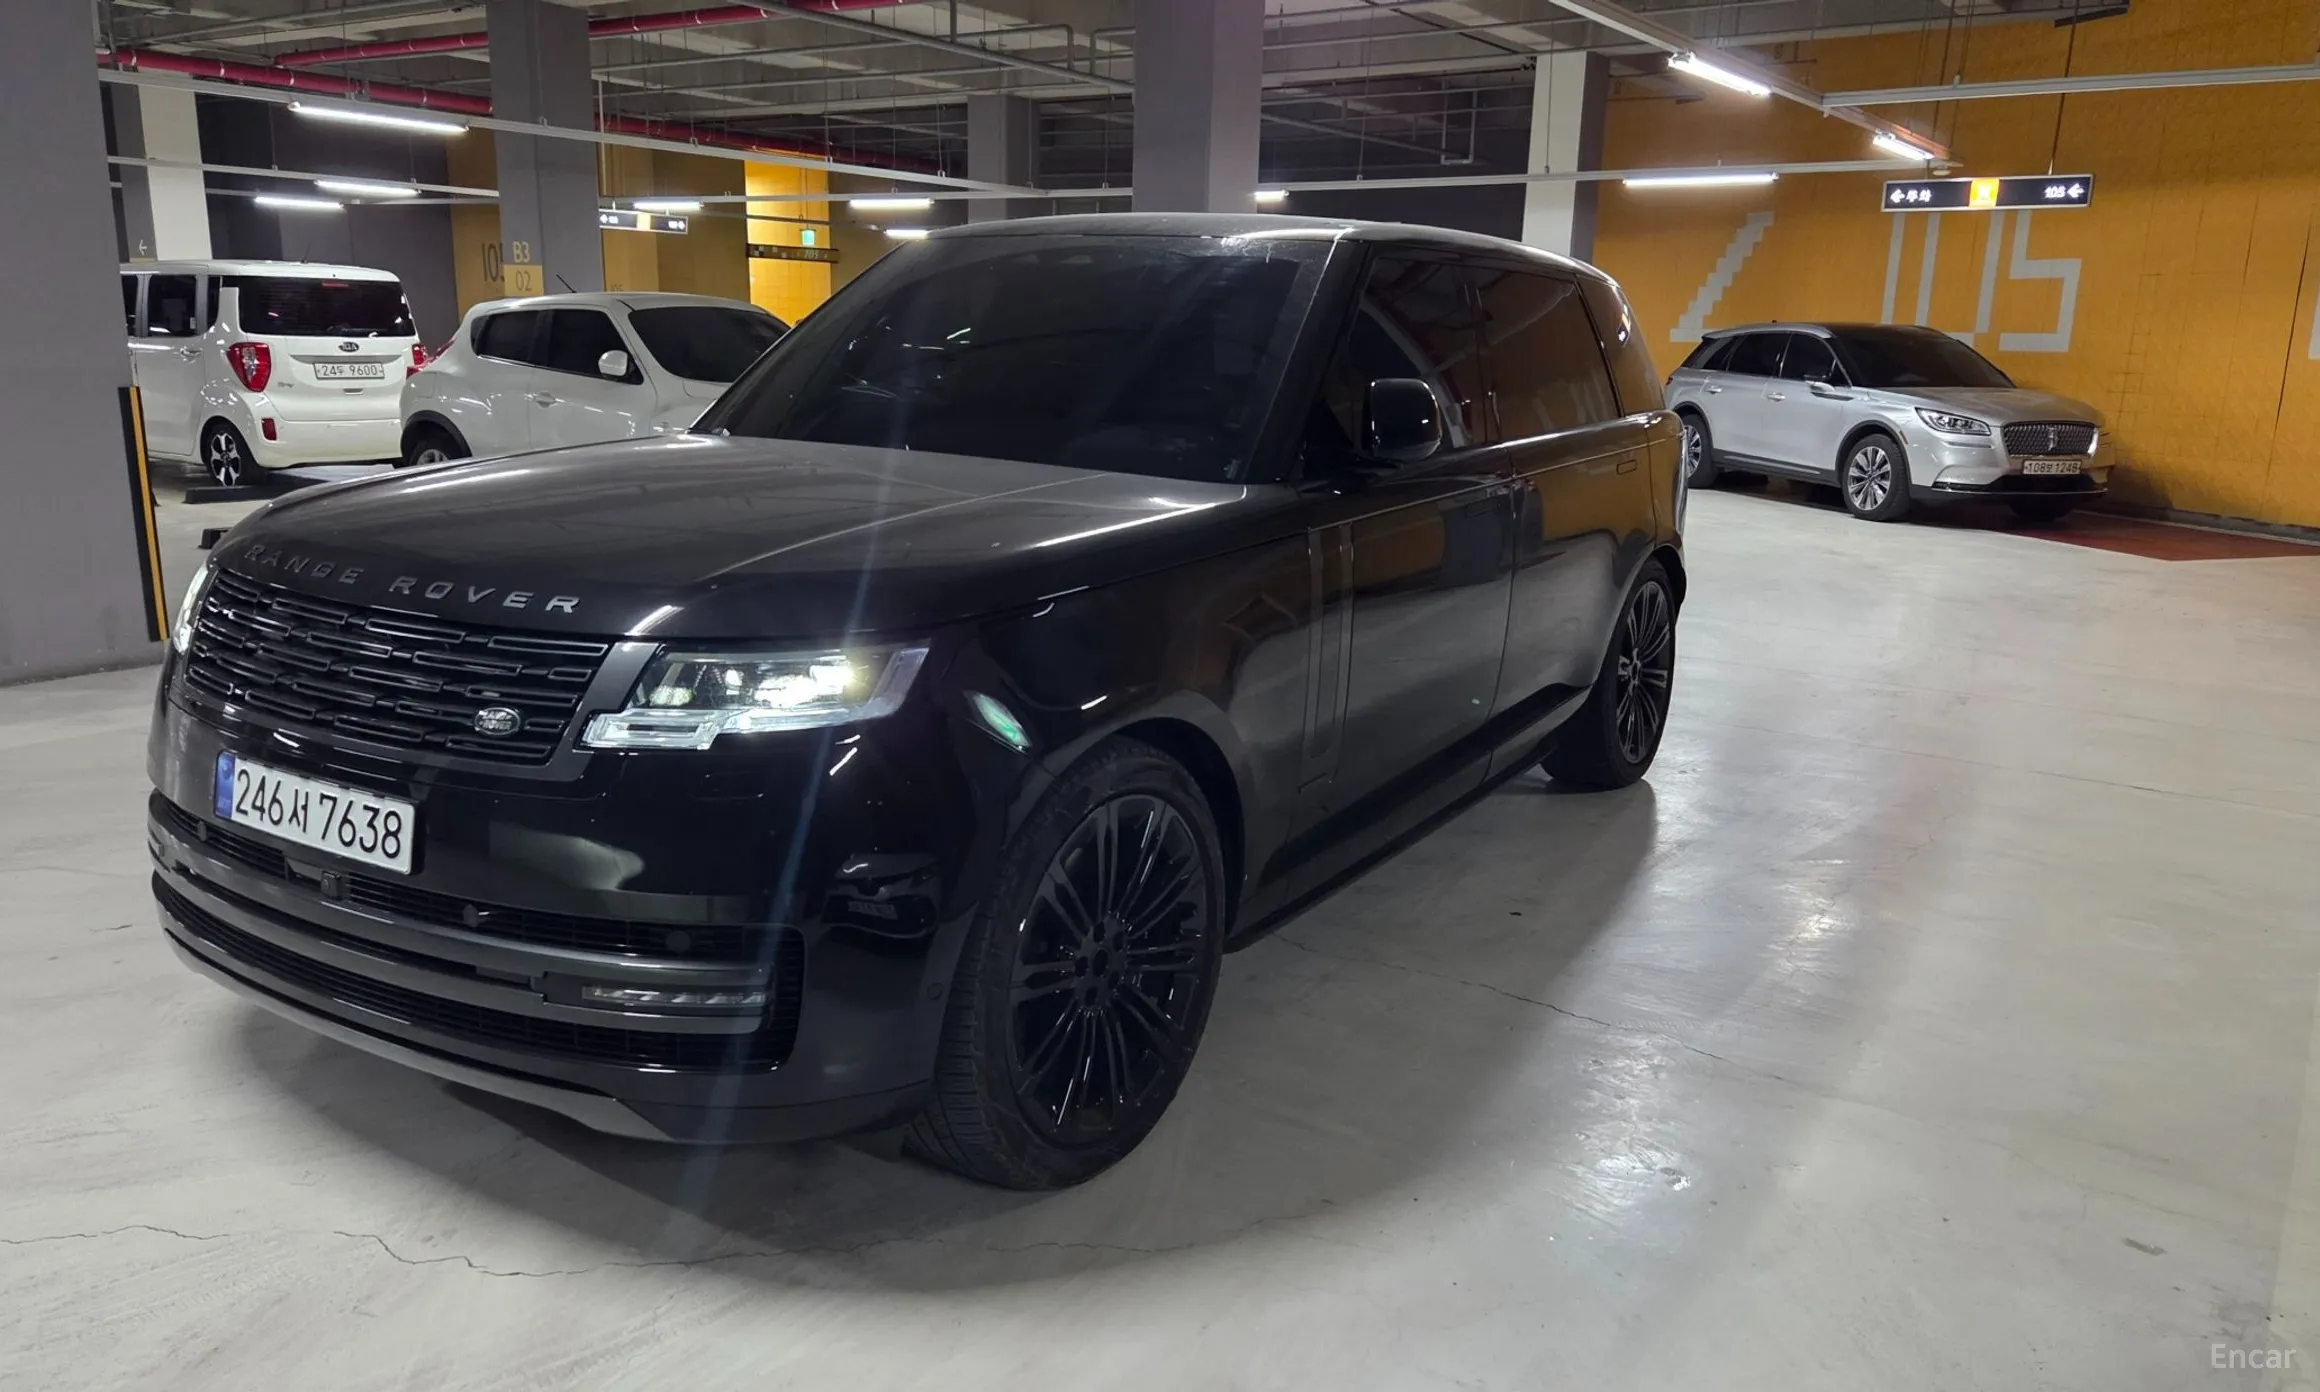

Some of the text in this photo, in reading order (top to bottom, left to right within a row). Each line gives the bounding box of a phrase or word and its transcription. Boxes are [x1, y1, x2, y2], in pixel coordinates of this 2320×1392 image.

[513, 240, 530, 263] B3
[515, 270, 532, 292] 02
[349, 364, 378, 377] 9600
[244, 545, 580, 614] RANGE ROVER
[235, 768, 401, 859] 246서 7638
